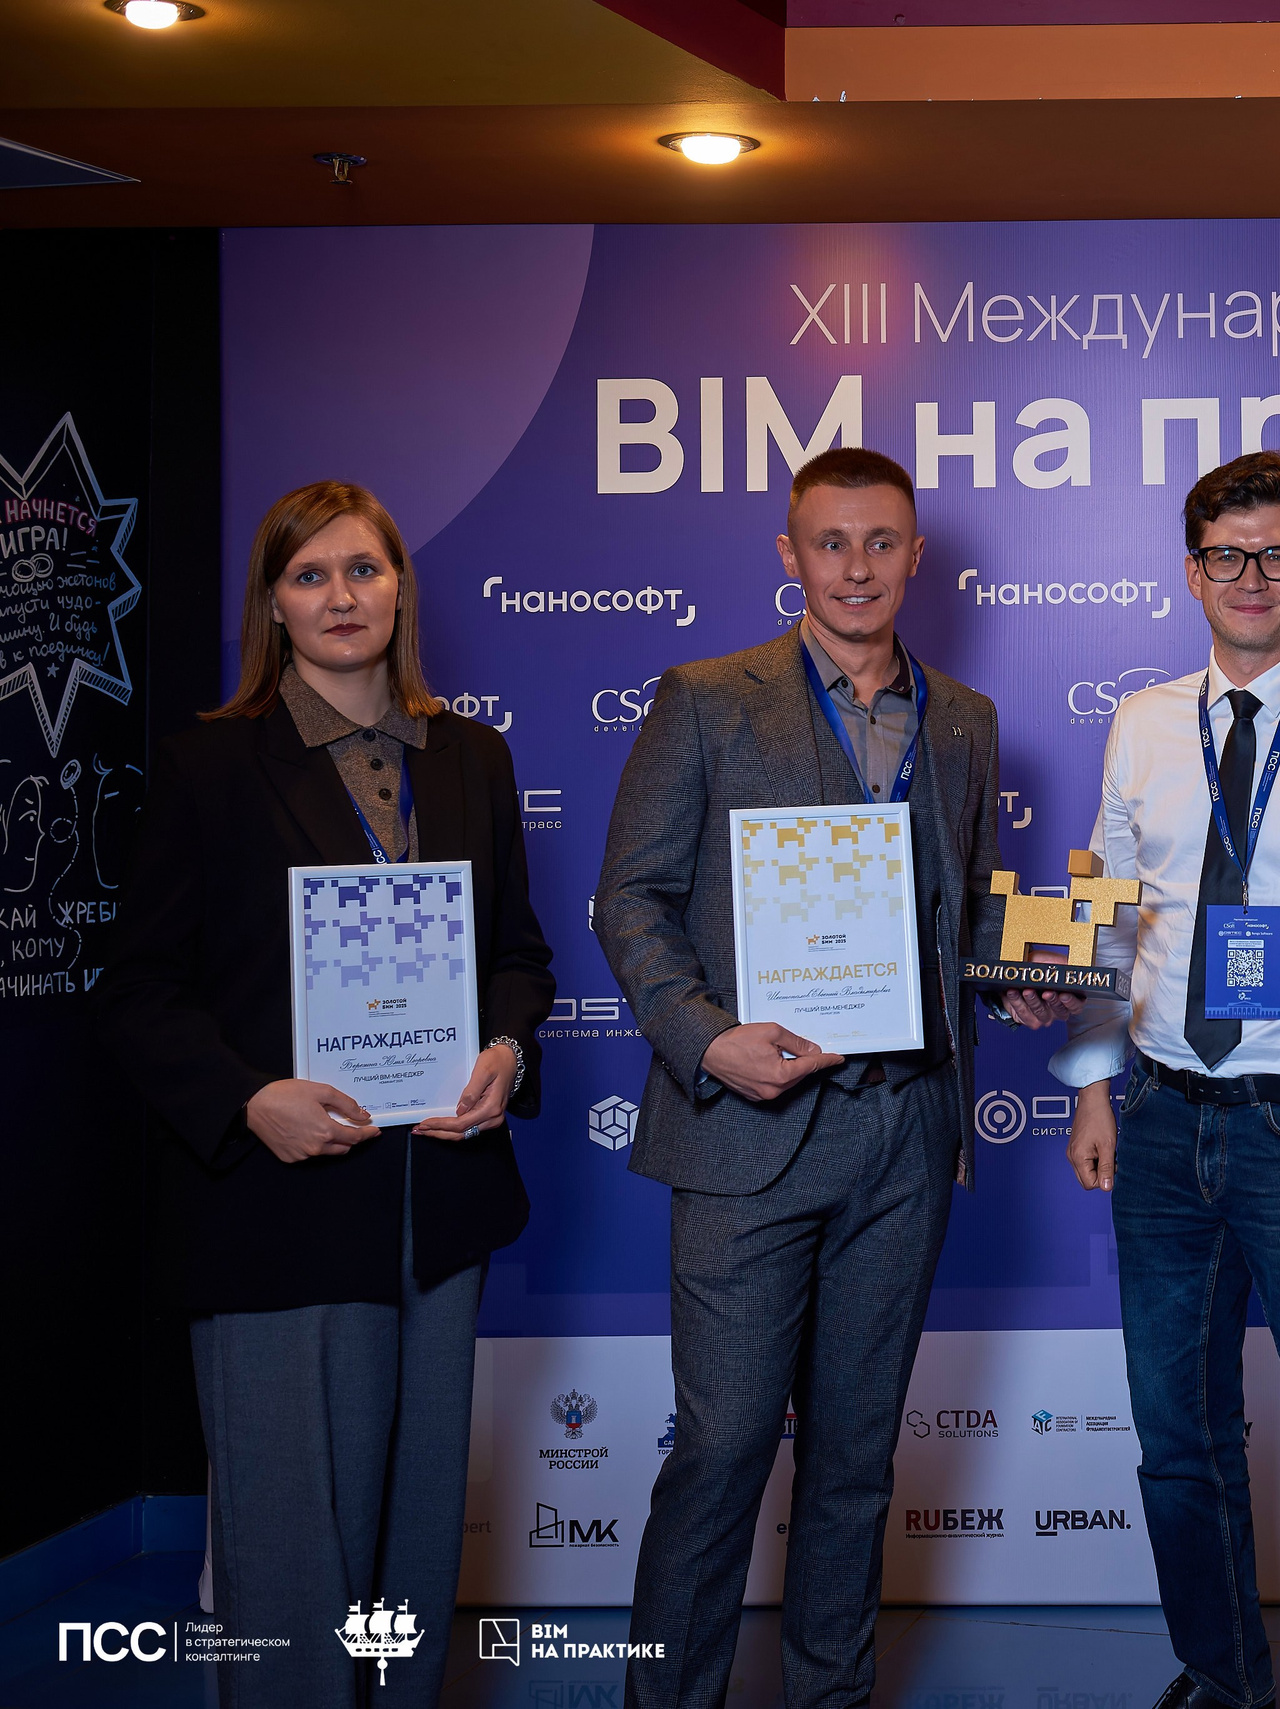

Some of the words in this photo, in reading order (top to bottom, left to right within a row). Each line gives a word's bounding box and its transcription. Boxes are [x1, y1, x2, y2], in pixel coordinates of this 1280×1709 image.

[789, 282, 889, 347] XIII
[596, 374, 863, 494] BIM
[915, 398, 1091, 490] на
[499, 583, 685, 617] нанософт
[974, 575, 1160, 608] нанософт
[900, 760, 913, 781] ПСС
[757, 961, 898, 985] НАГРАЖДАЕТСЯ
[963, 962, 1059, 985] ЗОЛОТОЙ
[1064, 967, 1111, 988] БИМ
[316, 1027, 457, 1053] НАГРАЖДАЕТСЯ
[537, 1028, 600, 1039] система
[936, 1409, 998, 1429] CTDA
[938, 1429, 999, 1438] SOLUTIONS
[538, 1446, 609, 1459] МИНСТРОЙ
[548, 1459, 599, 1470] РОССИИ
[905, 1508, 1005, 1531] RUБЕЖ
